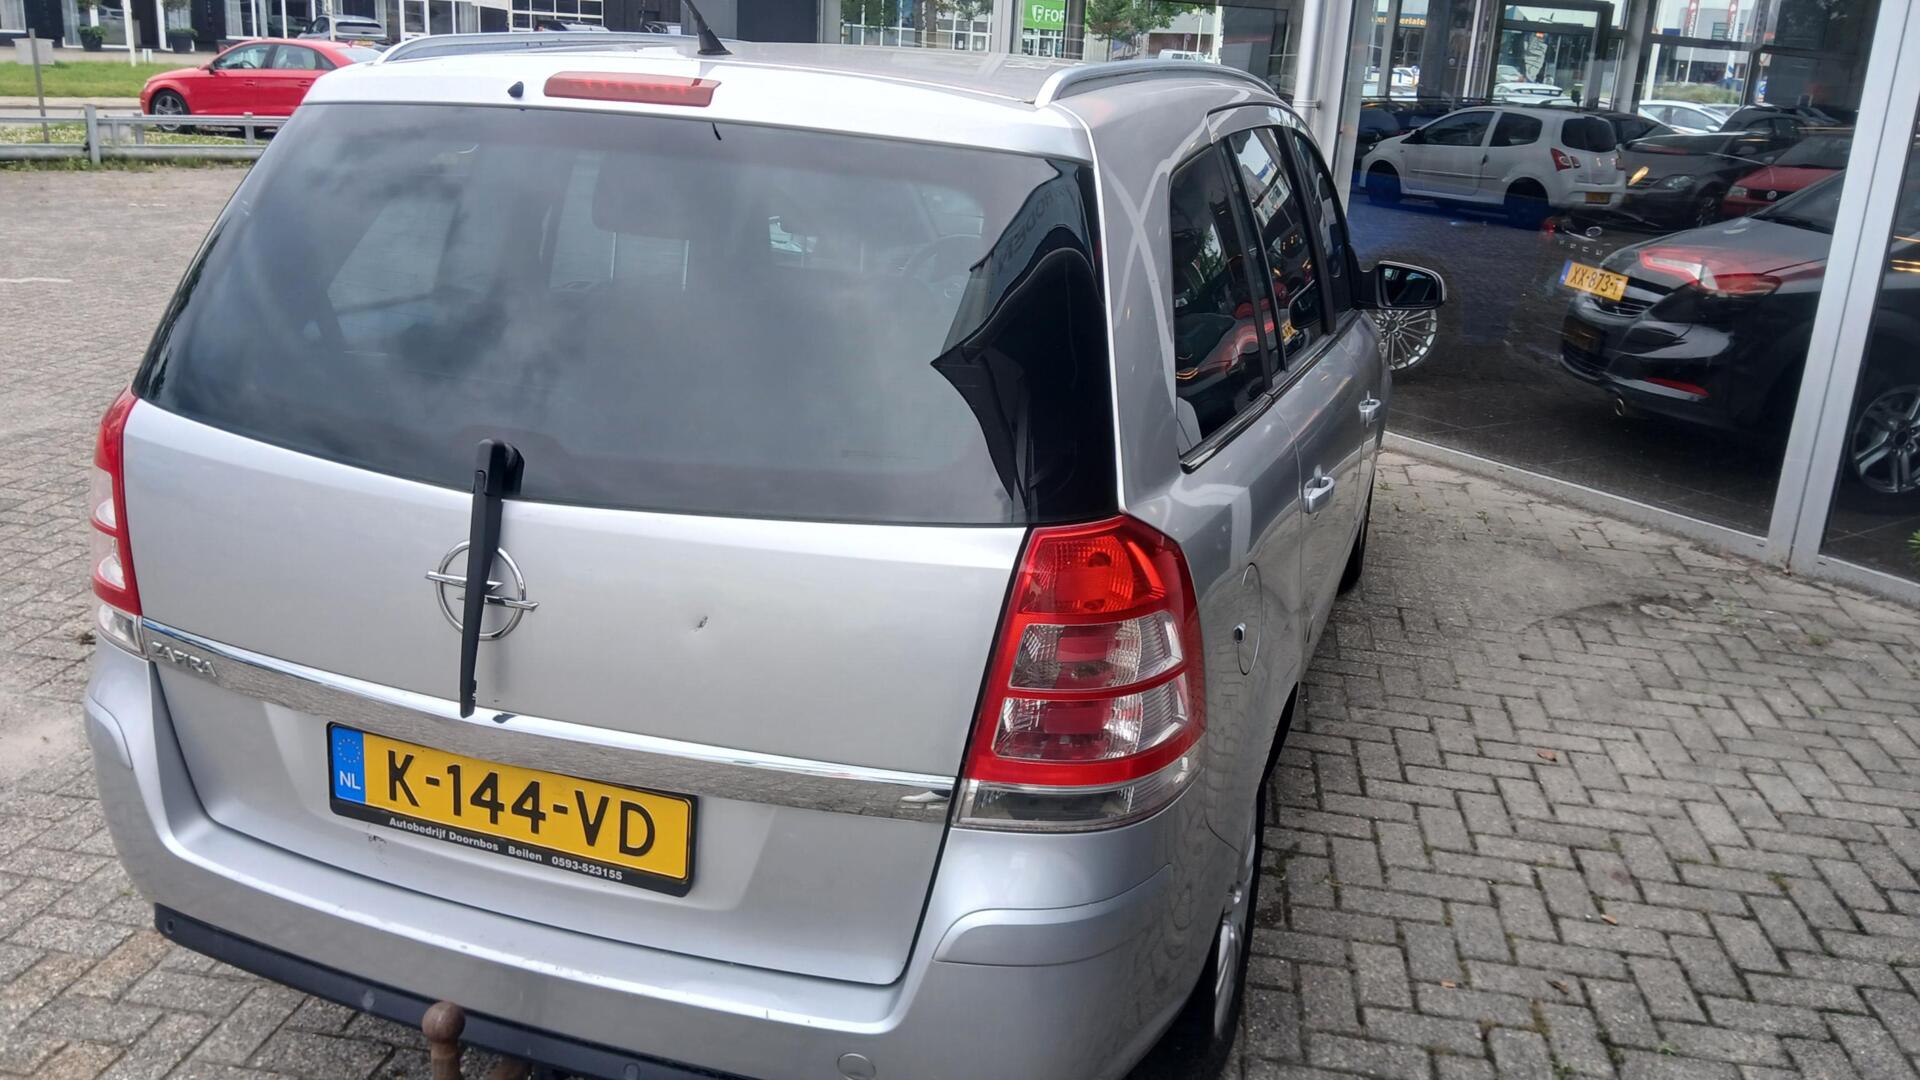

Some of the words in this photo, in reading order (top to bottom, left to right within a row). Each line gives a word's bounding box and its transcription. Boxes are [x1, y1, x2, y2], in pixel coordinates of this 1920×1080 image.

[339, 771, 362, 790] NL
[387, 750, 656, 857] K-144-VD
[389, 817, 447, 841] Autobedrijf
[449, 831, 499, 852] Doornbos
[508, 845, 543, 862] Beilen
[551, 855, 623, 881] 0593-523155
